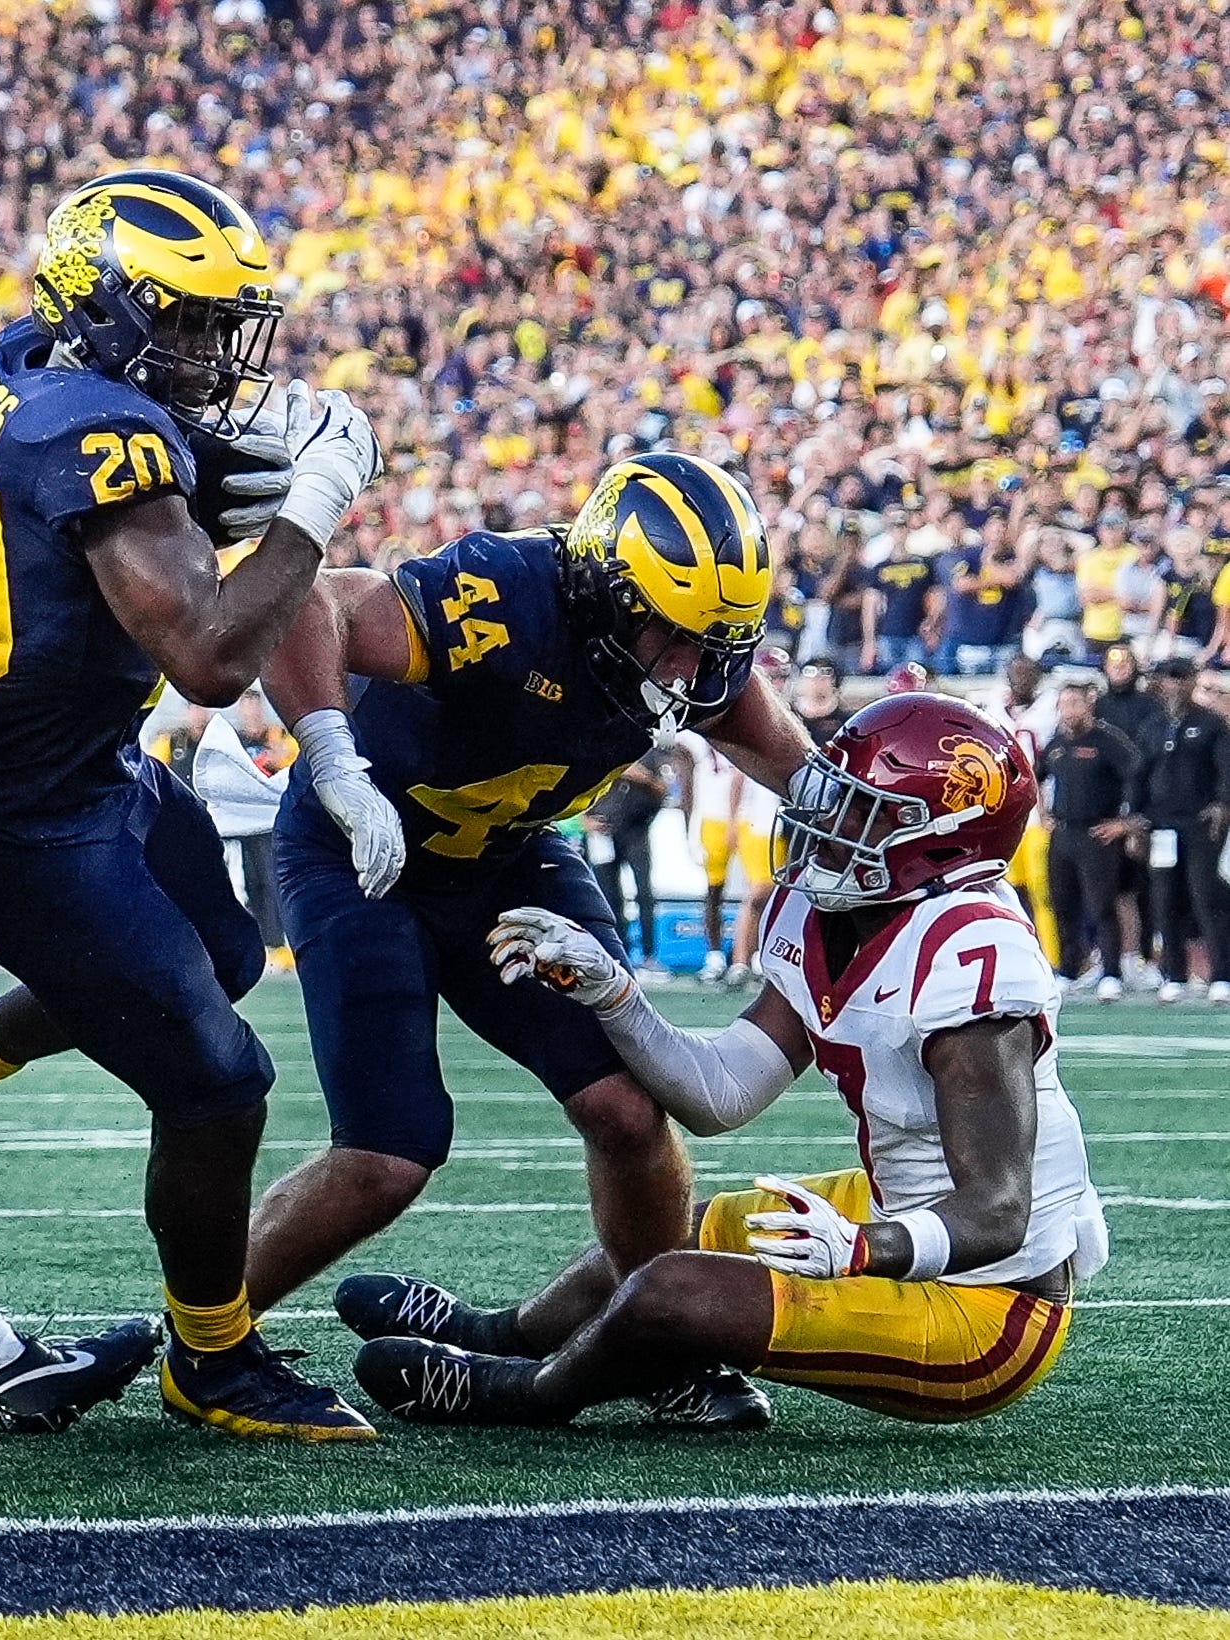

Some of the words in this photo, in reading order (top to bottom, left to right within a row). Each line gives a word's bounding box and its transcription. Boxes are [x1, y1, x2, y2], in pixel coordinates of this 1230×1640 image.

[81, 432, 172, 504] 20
[441, 571, 511, 672] 44
[523, 669, 563, 702] BIG
[958, 944, 998, 1014] 7
